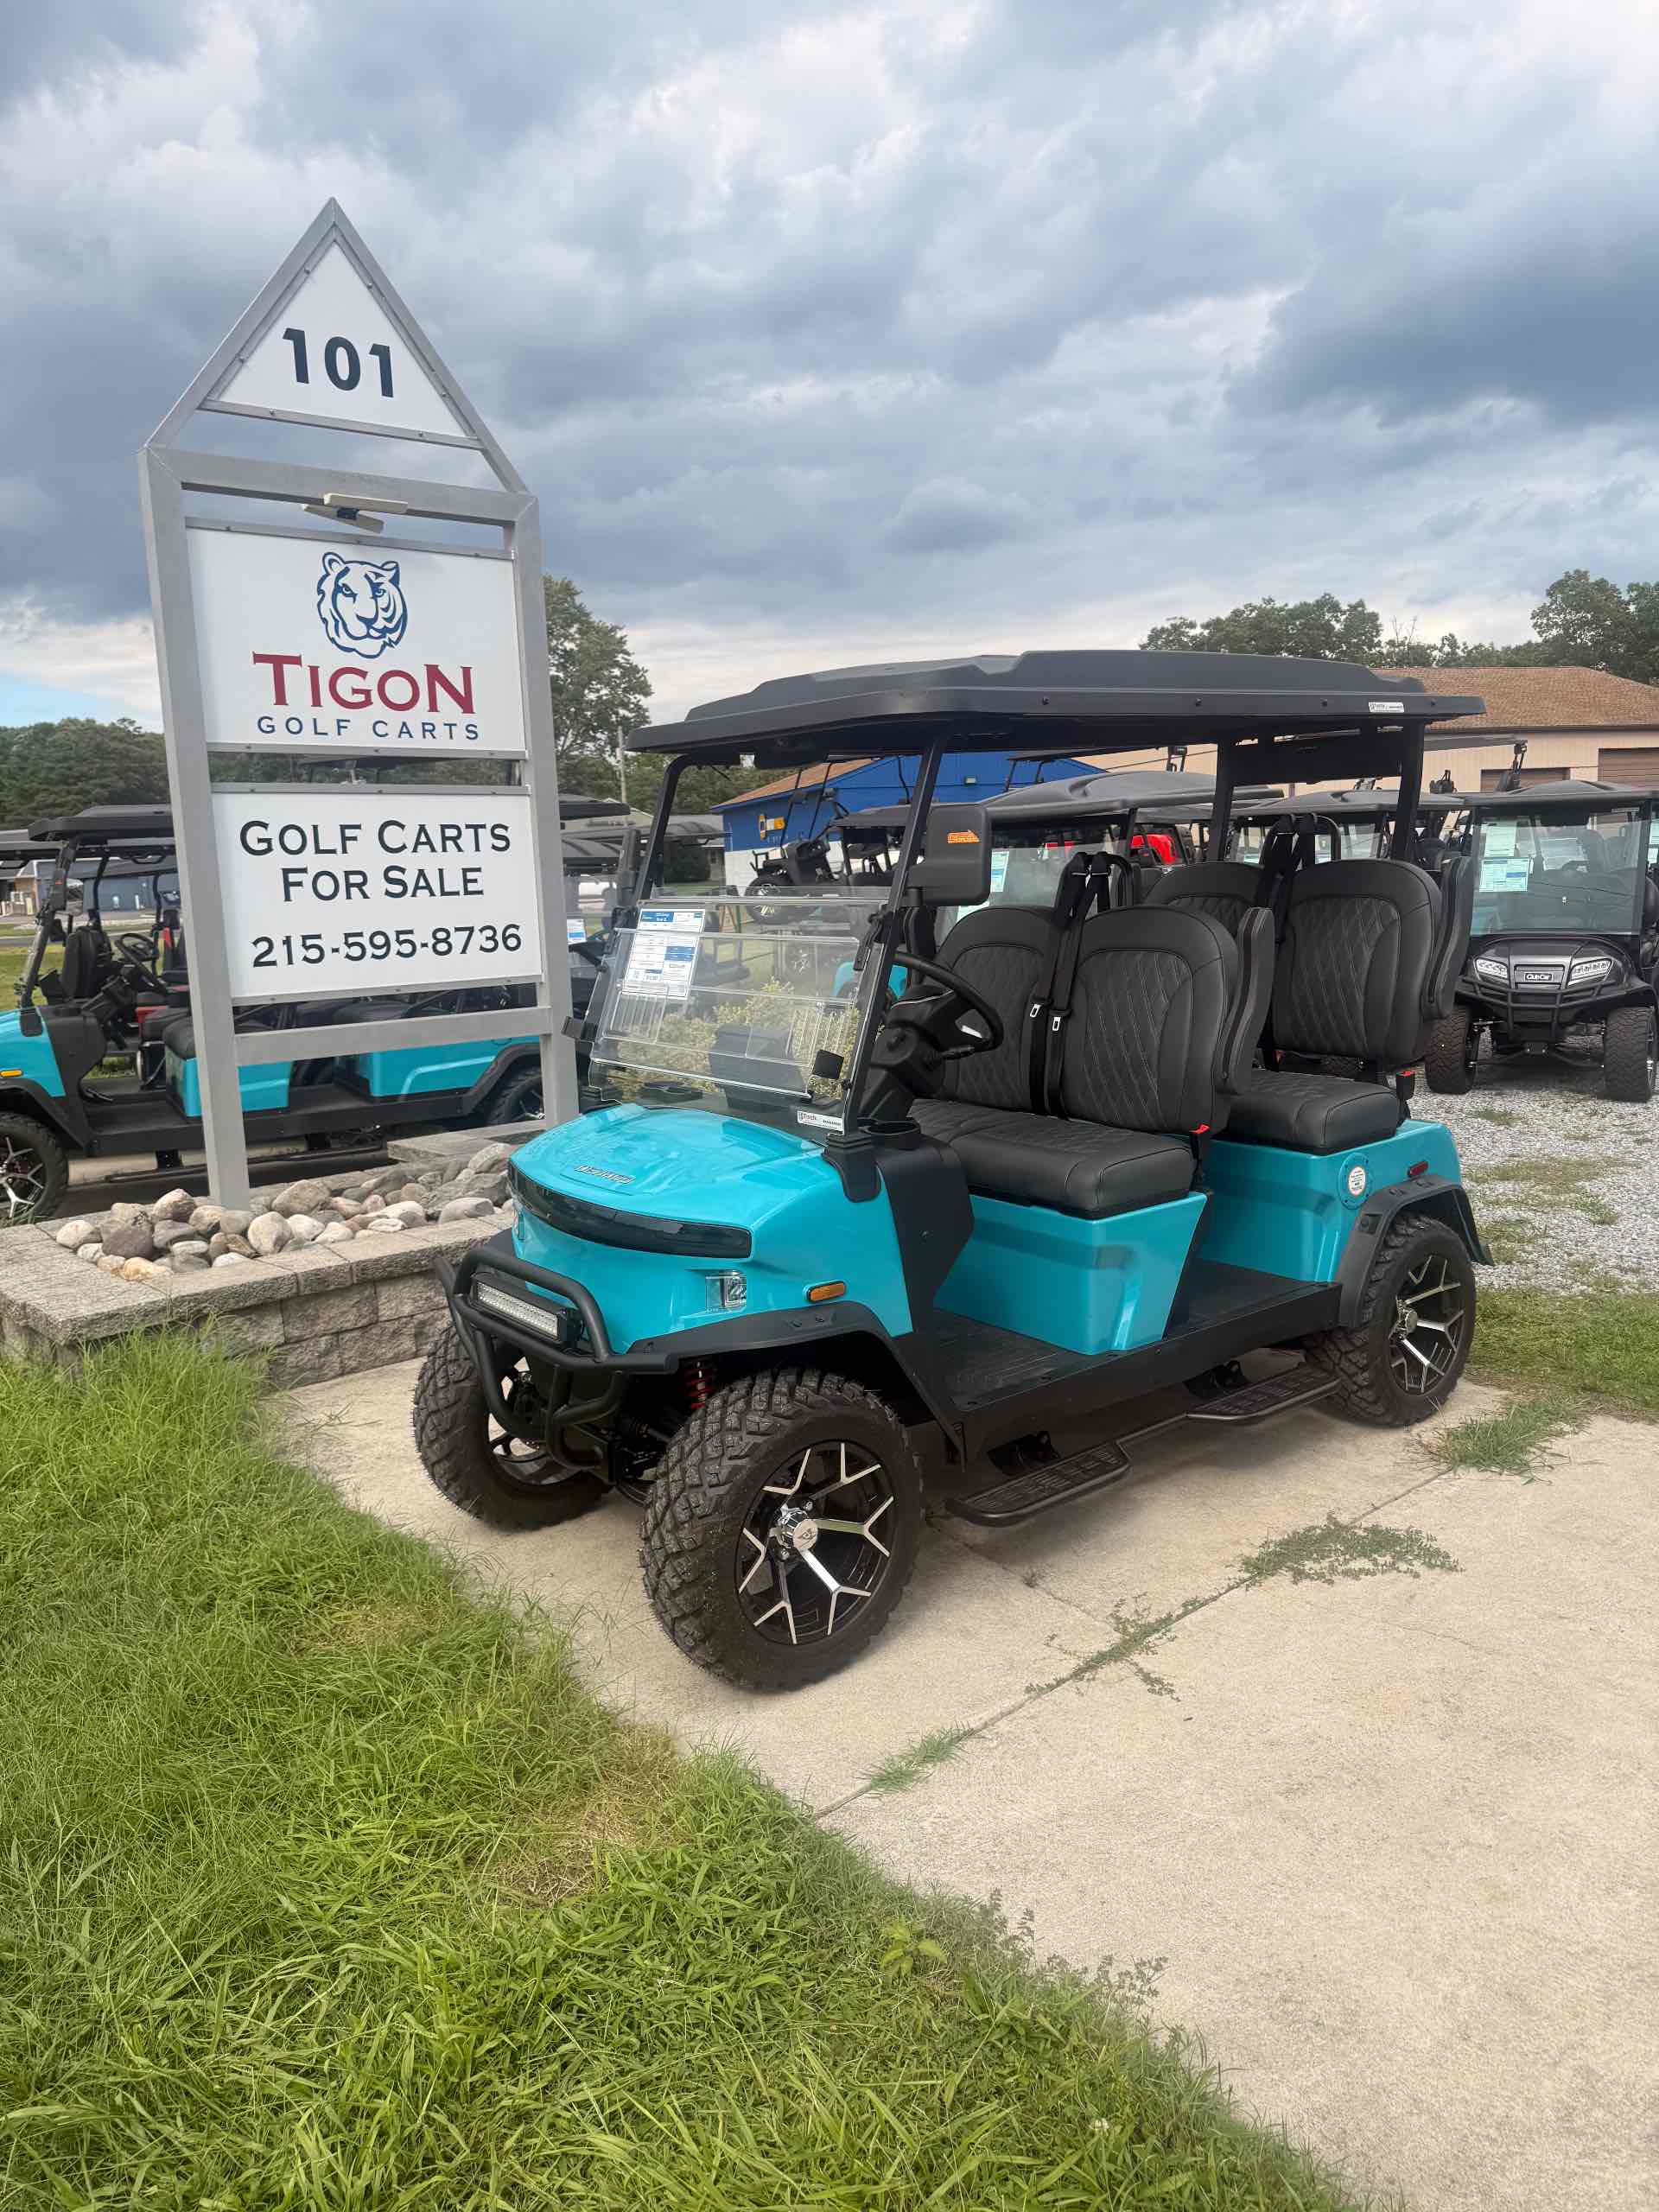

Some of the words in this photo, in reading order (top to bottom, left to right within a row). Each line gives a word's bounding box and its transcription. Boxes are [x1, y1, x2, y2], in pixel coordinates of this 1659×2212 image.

[282, 327, 395, 398] 101
[252, 651, 476, 715] TIGON
[257, 715, 351, 736] GOLF
[372, 719, 480, 741] CARTS
[239, 820, 362, 856] GOLF
[378, 819, 511, 855] CARTS
[281, 867, 371, 902] FOR
[383, 865, 485, 899] SALE
[251, 923, 522, 969] 215-595-8736
